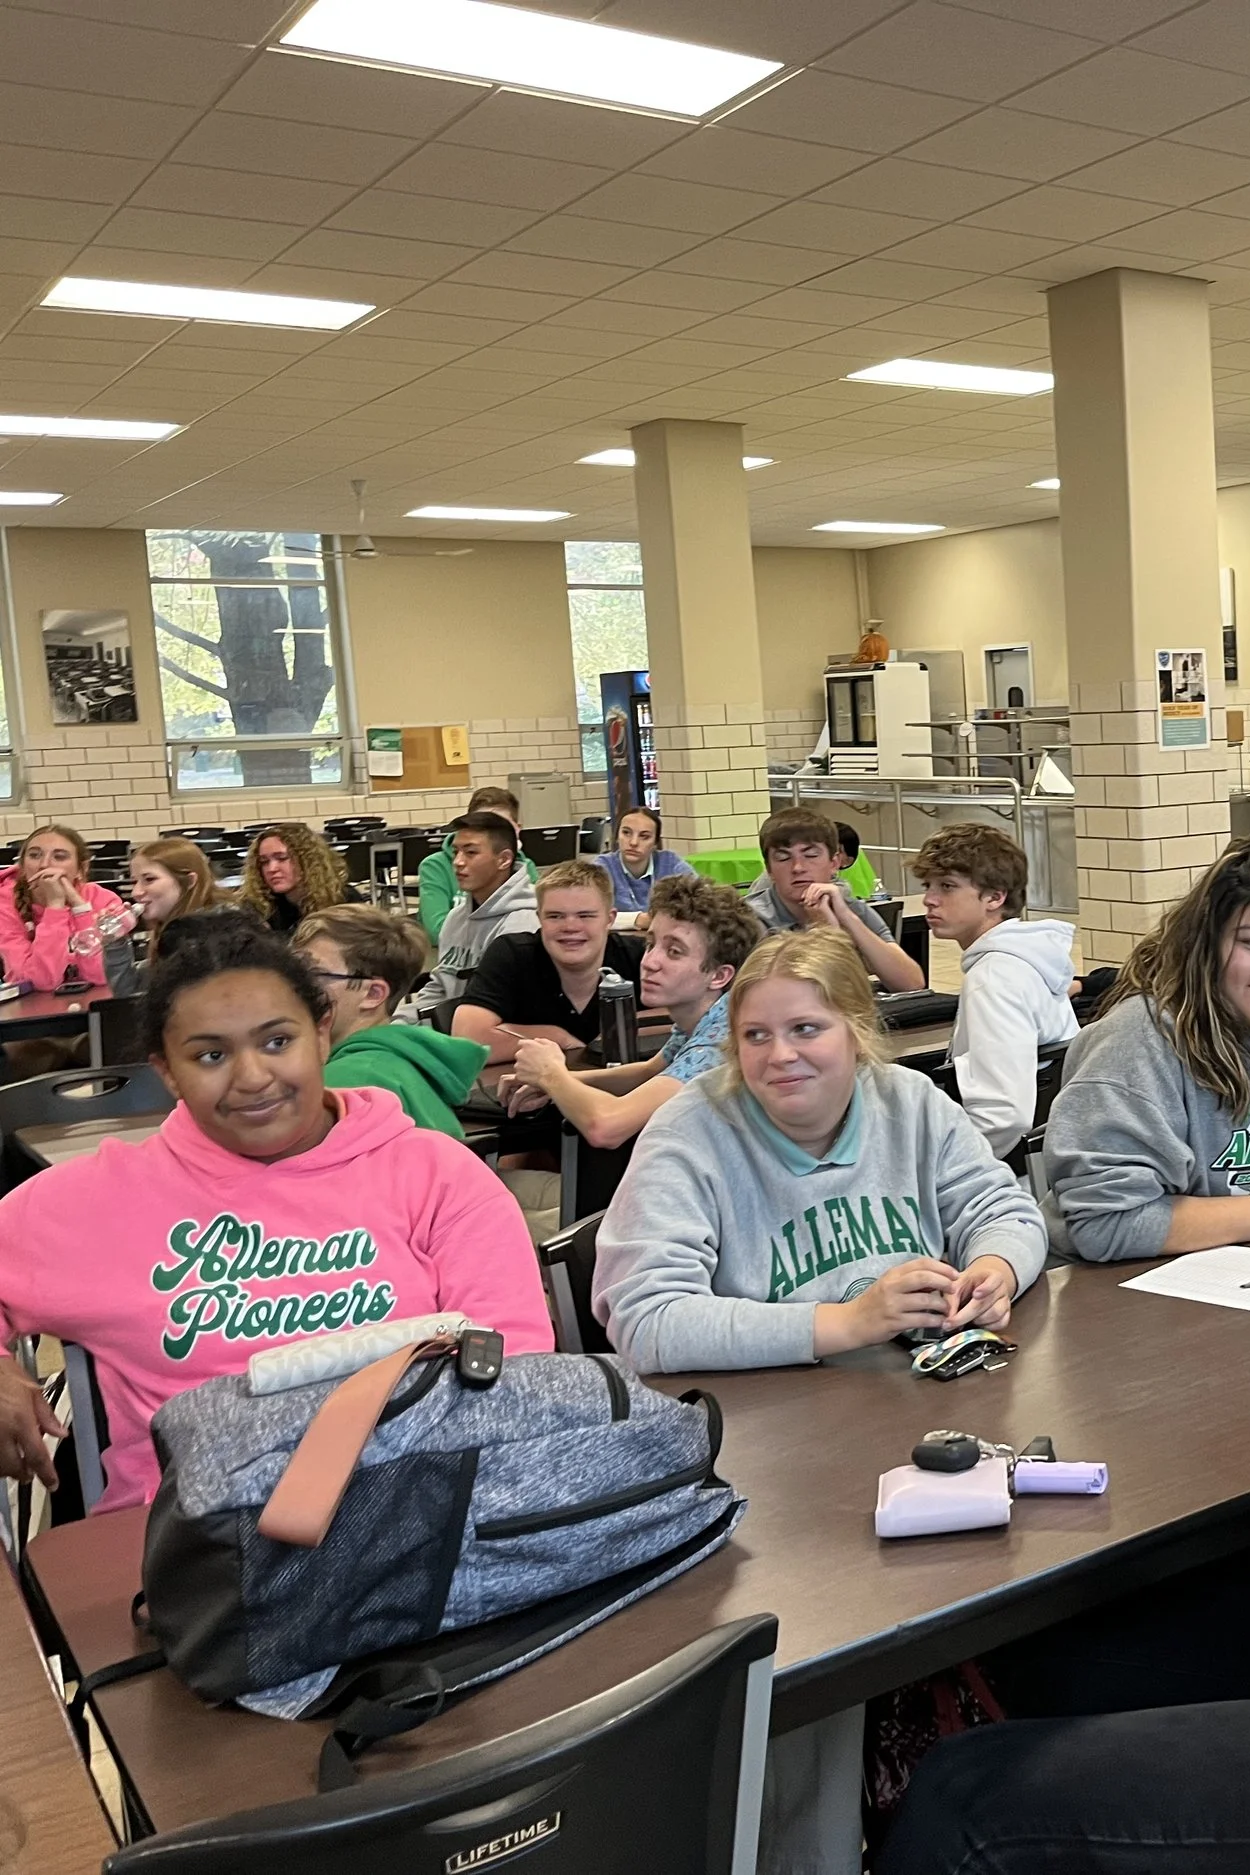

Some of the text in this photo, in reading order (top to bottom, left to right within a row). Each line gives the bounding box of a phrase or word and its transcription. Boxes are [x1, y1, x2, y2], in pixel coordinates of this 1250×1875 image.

[151, 1212, 379, 1293] Alleman
[162, 1280, 397, 1362] Pioneers
[456, 1818, 548, 1868] LIFETIME
